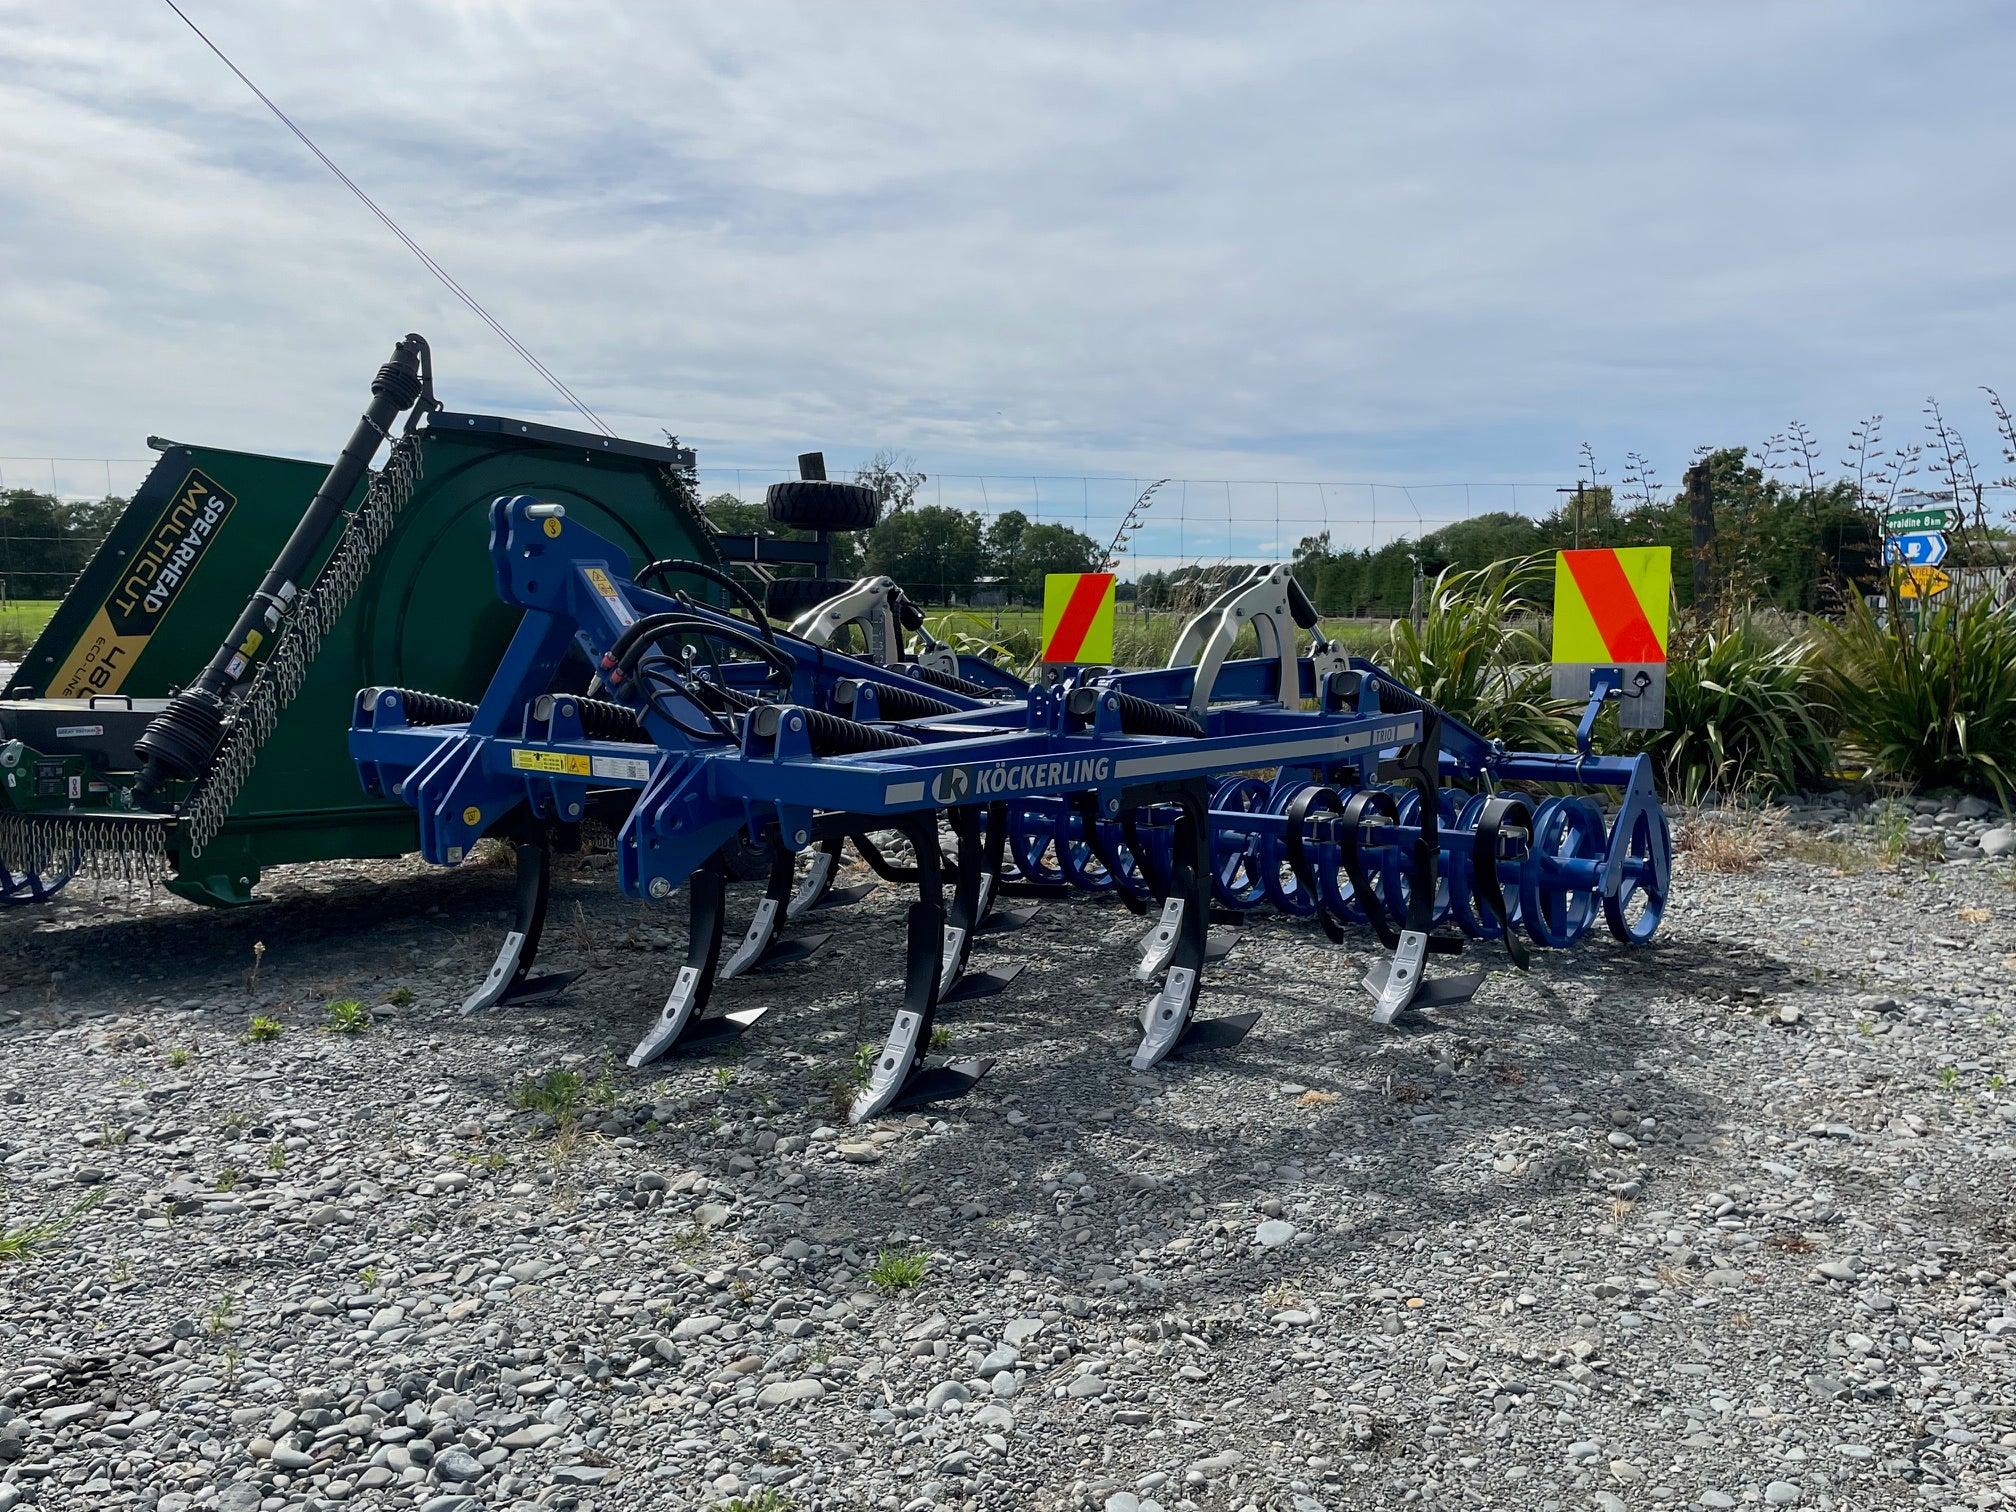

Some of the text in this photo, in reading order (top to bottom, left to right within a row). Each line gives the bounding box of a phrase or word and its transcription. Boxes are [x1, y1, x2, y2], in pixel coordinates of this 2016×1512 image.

[115, 481, 208, 617] MULTICUT
[143, 495, 225, 613] SPEARHEAD
[62, 636, 106, 697] ECO-LINE
[1376, 728, 1392, 743] TRIO
[976, 757, 1110, 795] KÖCKERLING
